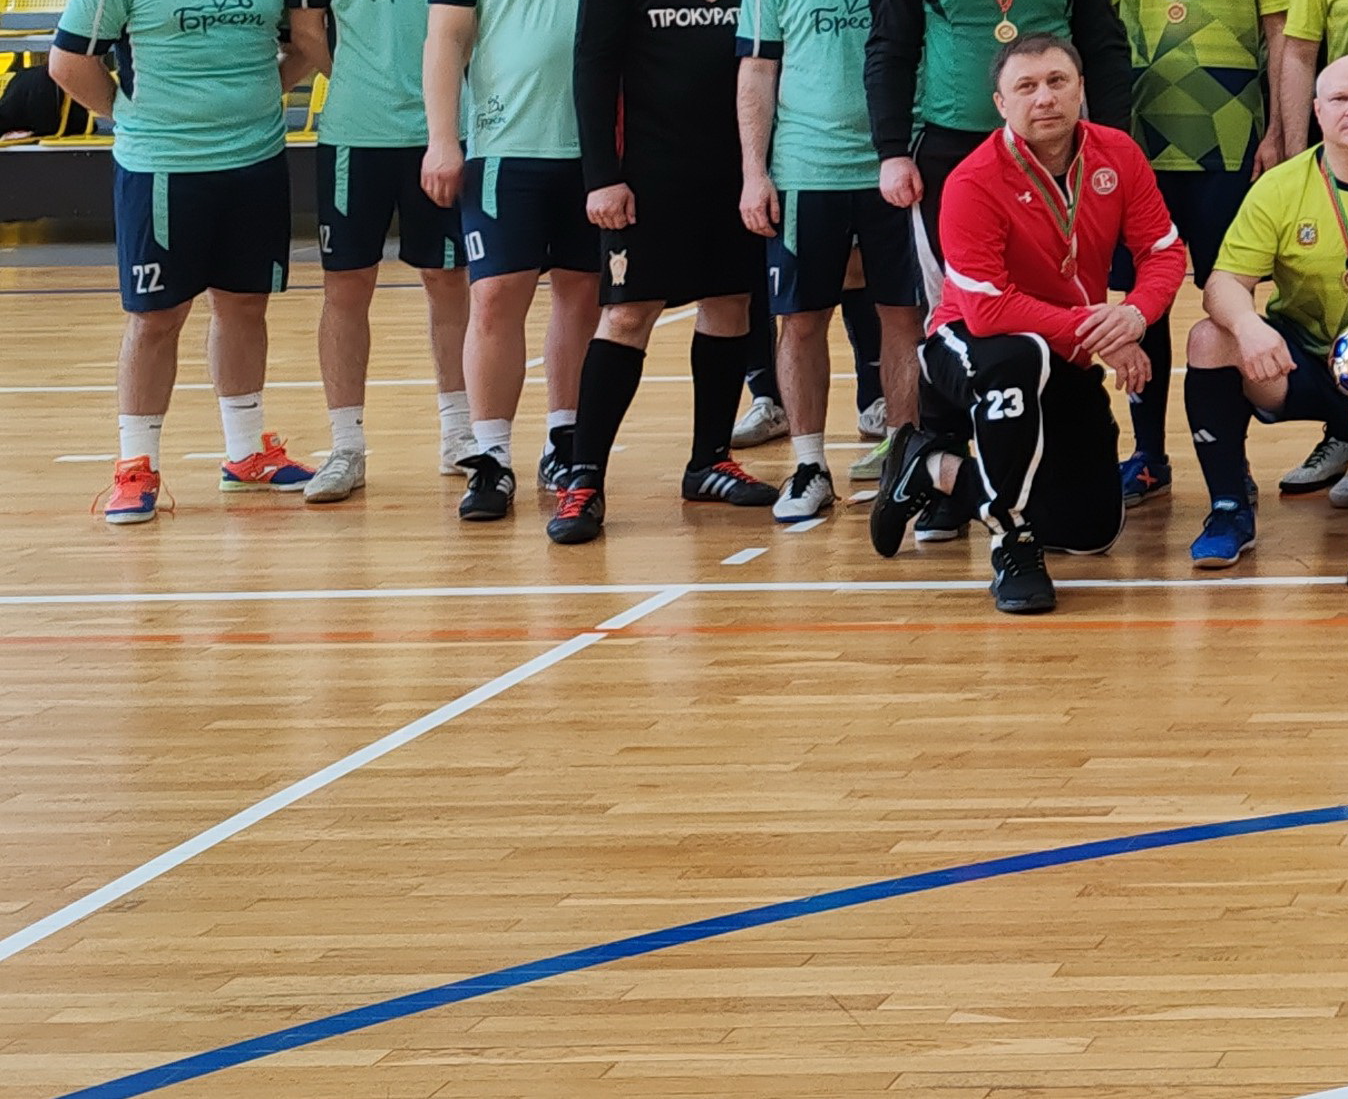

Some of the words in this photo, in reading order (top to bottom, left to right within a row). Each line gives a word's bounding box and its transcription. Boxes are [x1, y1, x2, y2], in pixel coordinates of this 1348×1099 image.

[174, 7, 265, 33] Брест
[132, 263, 165, 294] 22
[986, 387, 1024, 420] 23
